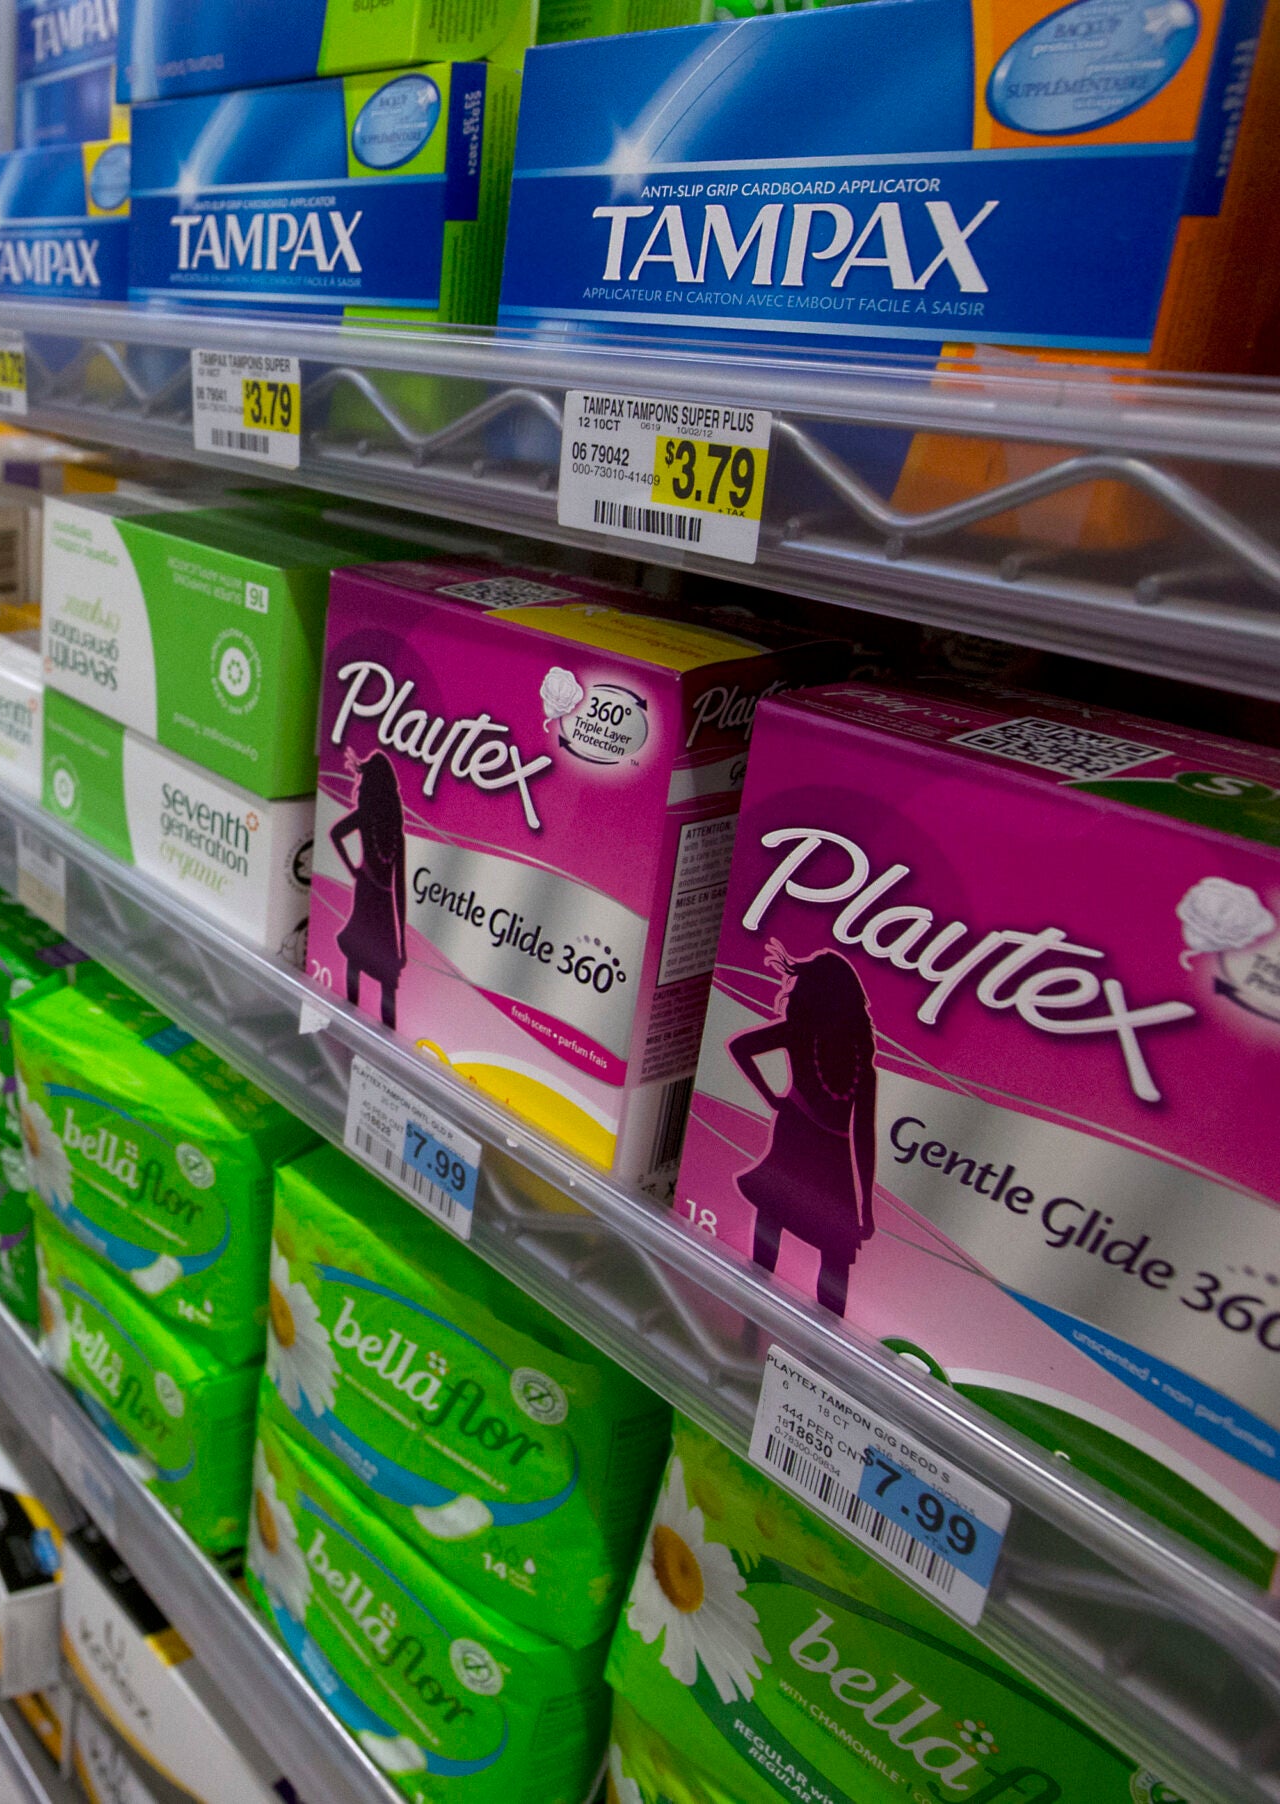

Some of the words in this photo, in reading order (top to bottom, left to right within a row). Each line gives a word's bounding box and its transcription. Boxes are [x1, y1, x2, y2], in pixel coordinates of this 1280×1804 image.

[641, 183, 703, 198] ANTI-SLIP
[706, 182, 738, 198] GRIP
[741, 180, 836, 197] CARDBOARD
[839, 178, 941, 195] APPLICATOR
[170, 210, 363, 273] TAMPAX
[592, 200, 1000, 293] TAMPAX
[583, 287, 662, 302] APPLICATEUR
[665, 290, 684, 303] EN
[686, 291, 743, 305] CARTON
[746, 293, 783, 308] AVEC
[787, 295, 856, 310] EMBOUT
[859, 298, 910, 313] FACILE
[913, 297, 927, 314] À
[931, 300, 986, 316] SAISIR
[264, 356, 291, 372] SUPER
[245, 381, 292, 428] $3.79
[578, 417, 590, 428] 12
[593, 418, 621, 431] 10CT
[583, 396, 624, 418] TAMPAX
[627, 401, 679, 424] TAMPONS
[681, 406, 720, 428] SUPER
[722, 411, 754, 433] PLUS
[572, 441, 587, 460] 06
[591, 444, 630, 466] 79042
[572, 463, 661, 486] 000-73010-41409
[665, 438, 755, 509] $3.79
[726, 508, 746, 517] TAX
[48, 617, 119, 662] generation
[48, 639, 118, 691] seventh
[572, 728, 625, 756] Protection
[575, 715, 602, 735] Triple
[604, 727, 632, 745] Layer
[586, 697, 632, 726] 360°
[686, 680, 788, 748] Play
[331, 661, 551, 829] Playtex
[160, 813, 248, 877] generation
[161, 783, 250, 854] seventh
[160, 841, 231, 896] organic
[413, 867, 486, 927] Gentle
[488, 908, 554, 964] Glide
[741, 827, 1196, 1102] Playtex
[511, 1005, 531, 1025] fresh
[531, 1019, 553, 1037] scent
[558, 1035, 589, 1058] parfum
[589, 1050, 607, 1069] frais
[63, 1107, 140, 1189] bella
[686, 1199, 717, 1236] 18
[890, 1116, 1034, 1214] Gentle
[1041, 1196, 1175, 1290] Glide
[71, 1303, 121, 1397] bella
[333, 1296, 442, 1411] bella
[417, 1379, 545, 1467] flor
[766, 1354, 817, 1394] PLAYTEX
[821, 1390, 871, 1430] TAMPON
[900, 1441, 938, 1476] DEOD
[941, 1471, 951, 1484] S
[806, 1418, 834, 1444] PER
[818, 1404, 830, 1418] 18
[832, 1414, 850, 1430] CT
[863, 1447, 977, 1556] $7.99
[308, 1528, 391, 1655] bella
[377, 1635, 474, 1723] flor
[779, 1678, 808, 1707] WITH
[809, 1704, 901, 1784] CHAMOMILE
[789, 1608, 979, 1791] bella
[734, 1719, 808, 1788] REGULAR
[748, 1746, 812, 1804] REGULAR
